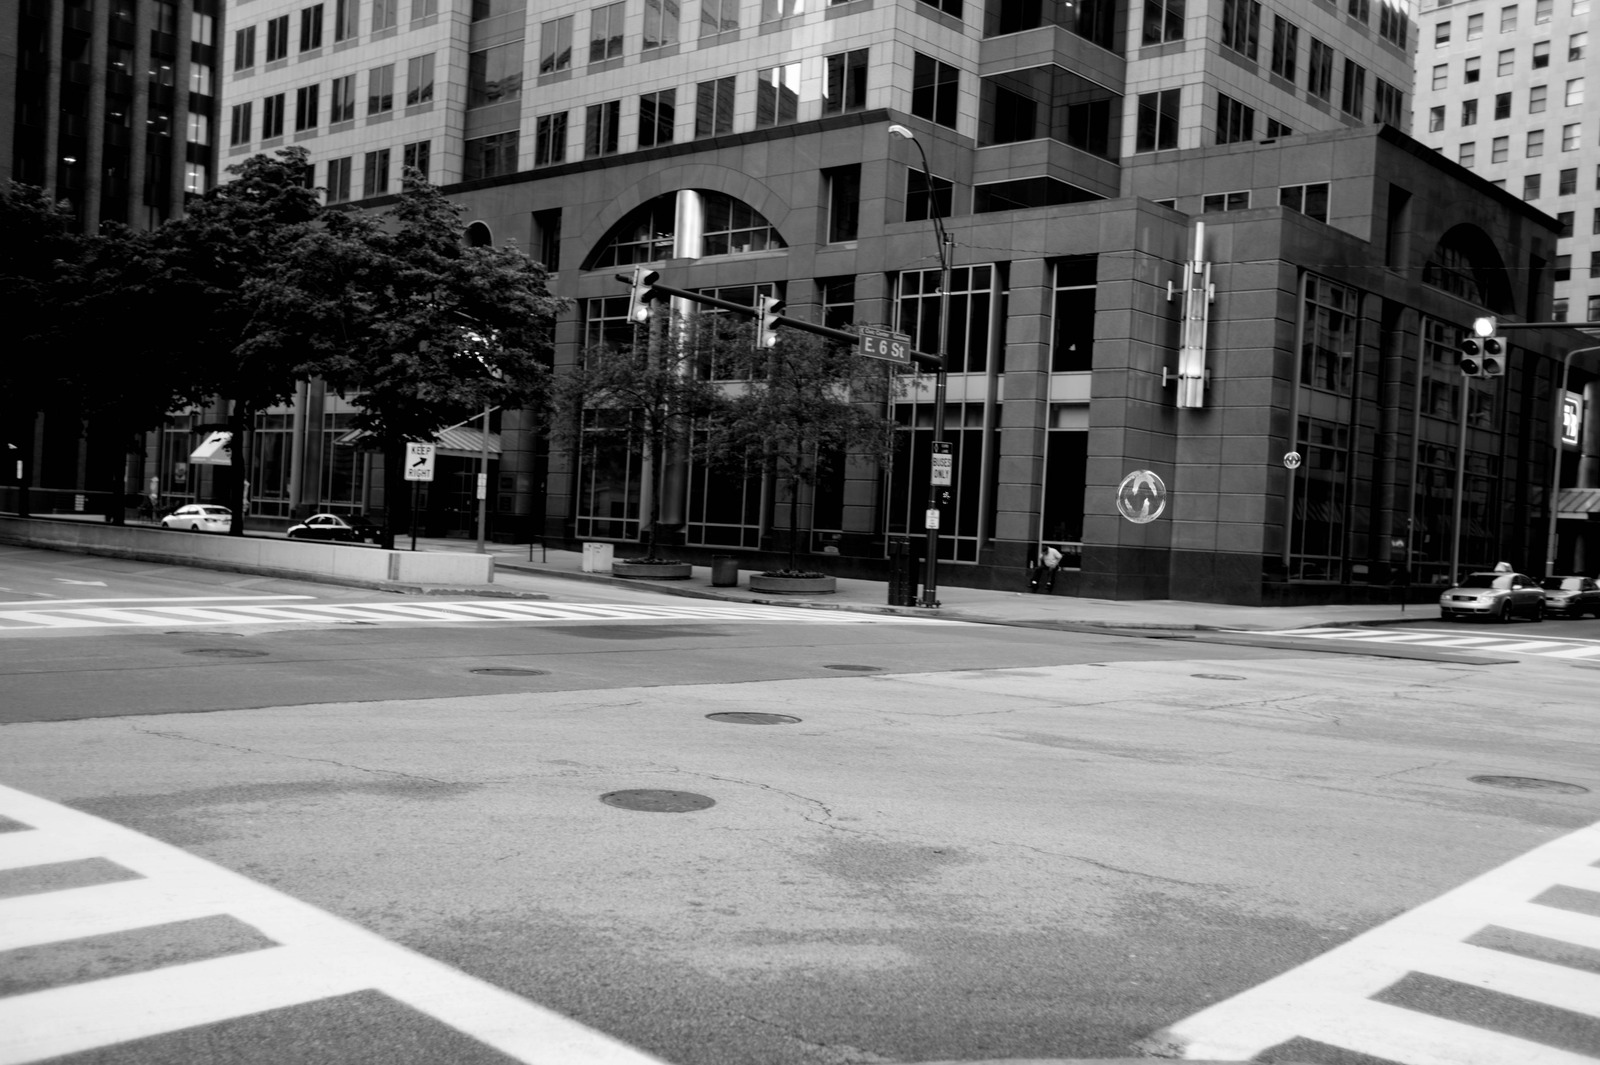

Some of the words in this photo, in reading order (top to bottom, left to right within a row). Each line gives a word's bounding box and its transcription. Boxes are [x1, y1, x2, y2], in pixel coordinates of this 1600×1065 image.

[879, 340, 888, 355] 6
[891, 342, 904, 358] St
[411, 446, 431, 455] KEEP
[933, 458, 951, 467] BUSES
[408, 468, 431, 477] RIGHT
[934, 469, 949, 479] ONLY
